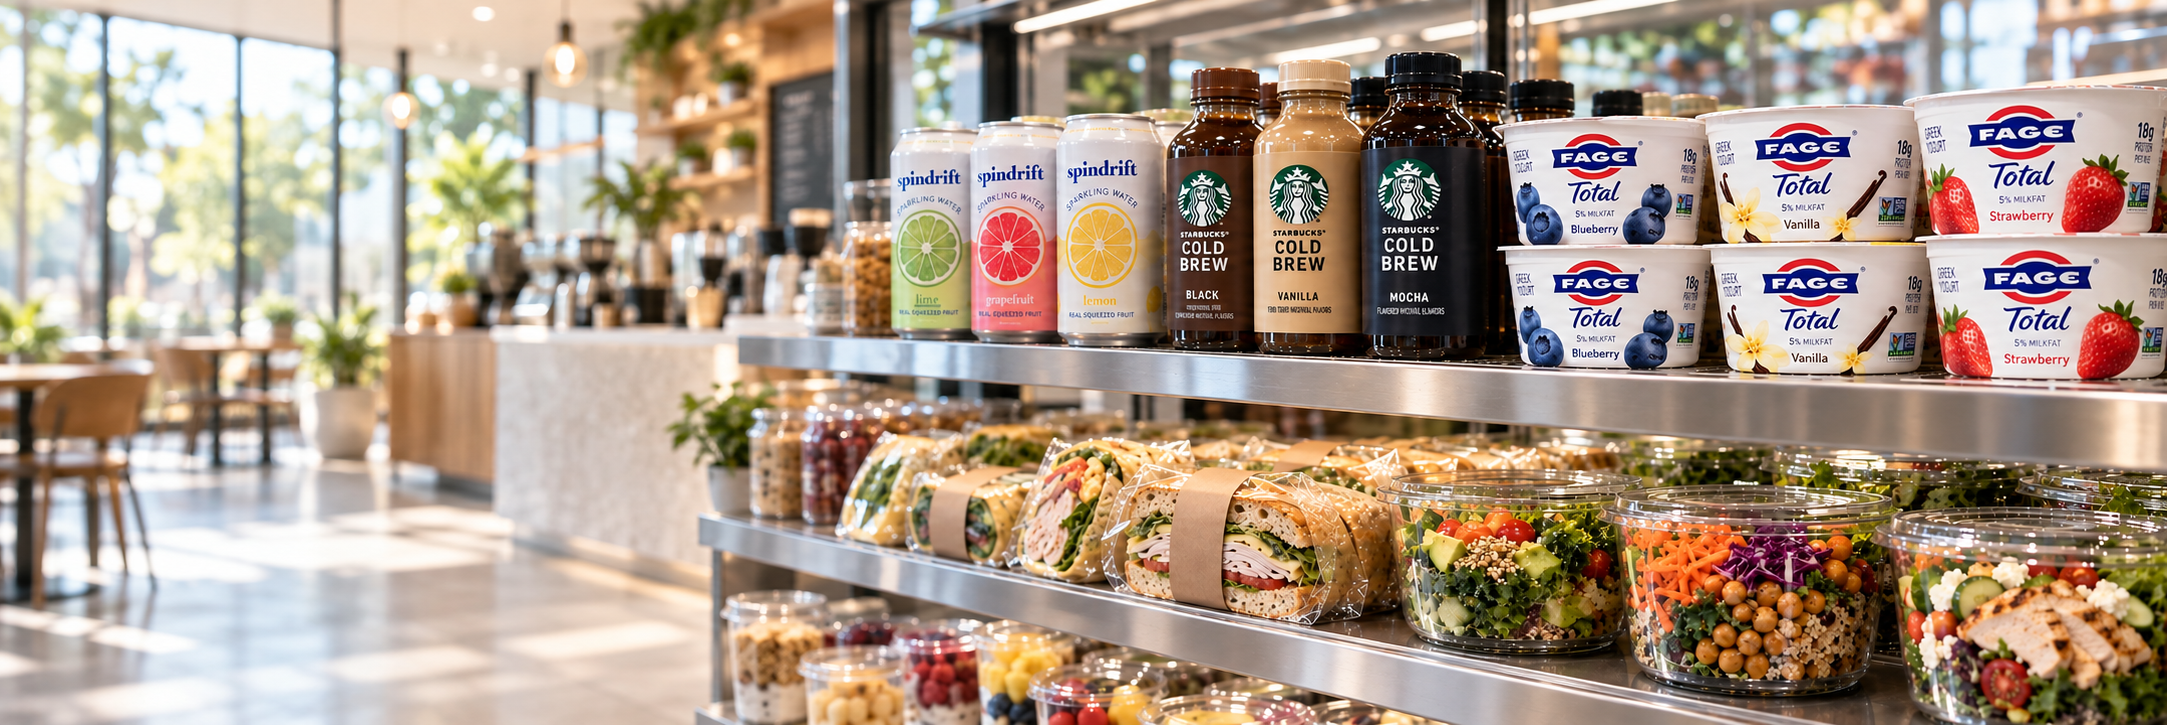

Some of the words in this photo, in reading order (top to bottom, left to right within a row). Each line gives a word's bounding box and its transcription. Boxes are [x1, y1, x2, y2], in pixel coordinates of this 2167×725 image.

[1979, 125, 2063, 141] FAGE
[2138, 122, 2154, 141] 18g
[1765, 141, 1840, 155] FAGE
[1898, 140, 1912, 158] 18g
[1561, 152, 1628, 163] FAGE
[1683, 148, 1697, 164] 18g
[977, 164, 1045, 188] spindrift
[1067, 159, 1138, 184] spindrift
[1988, 160, 2055, 189] Total
[897, 169, 961, 191] spindrift
[1772, 172, 1832, 197] Total
[1112, 188, 1138, 209] WATER
[1567, 181, 1621, 204] Total
[1999, 195, 2011, 204] 5%
[2014, 195, 2046, 203] MILKFAT
[937, 196, 962, 215] WATER
[1020, 193, 1045, 212] WATER
[1782, 203, 1793, 212] 5%
[1796, 203, 1825, 211] MILKFAT
[1990, 210, 2054, 223] Strawberry
[1571, 225, 1619, 236] Blueberry
[1784, 219, 1820, 229] Vanilla
[1182, 241, 1225, 255] COLD
[1275, 240, 1321, 254] COLD
[1384, 238, 1434, 253] COLD
[1180, 257, 1229, 272] BREW
[1273, 257, 1325, 271] BREW
[1381, 256, 1438, 271] BREW
[1562, 278, 1630, 289] FAGE
[1685, 275, 1700, 291] 18g
[1772, 277, 1848, 289] FAGE
[1907, 276, 1922, 292] 18g
[1994, 271, 2079, 285] FAGE
[916, 293, 939, 304] lime
[986, 293, 1034, 307] grapefruit
[1083, 294, 1117, 306] lemon
[1186, 290, 1219, 300] BLACK
[1278, 292, 1319, 301] VANILLA
[1390, 292, 1429, 303] MOCHA
[1569, 307, 1622, 328] Total
[1780, 308, 1840, 331] Total
[2003, 306, 2071, 332] Total
[2014, 339, 2027, 347] 5%
[2029, 339, 2061, 347] MILKFAT
[1572, 348, 1620, 360] Blueberry
[1791, 353, 1828, 363] Vanilla
[2004, 353, 2070, 367] Strawberry
